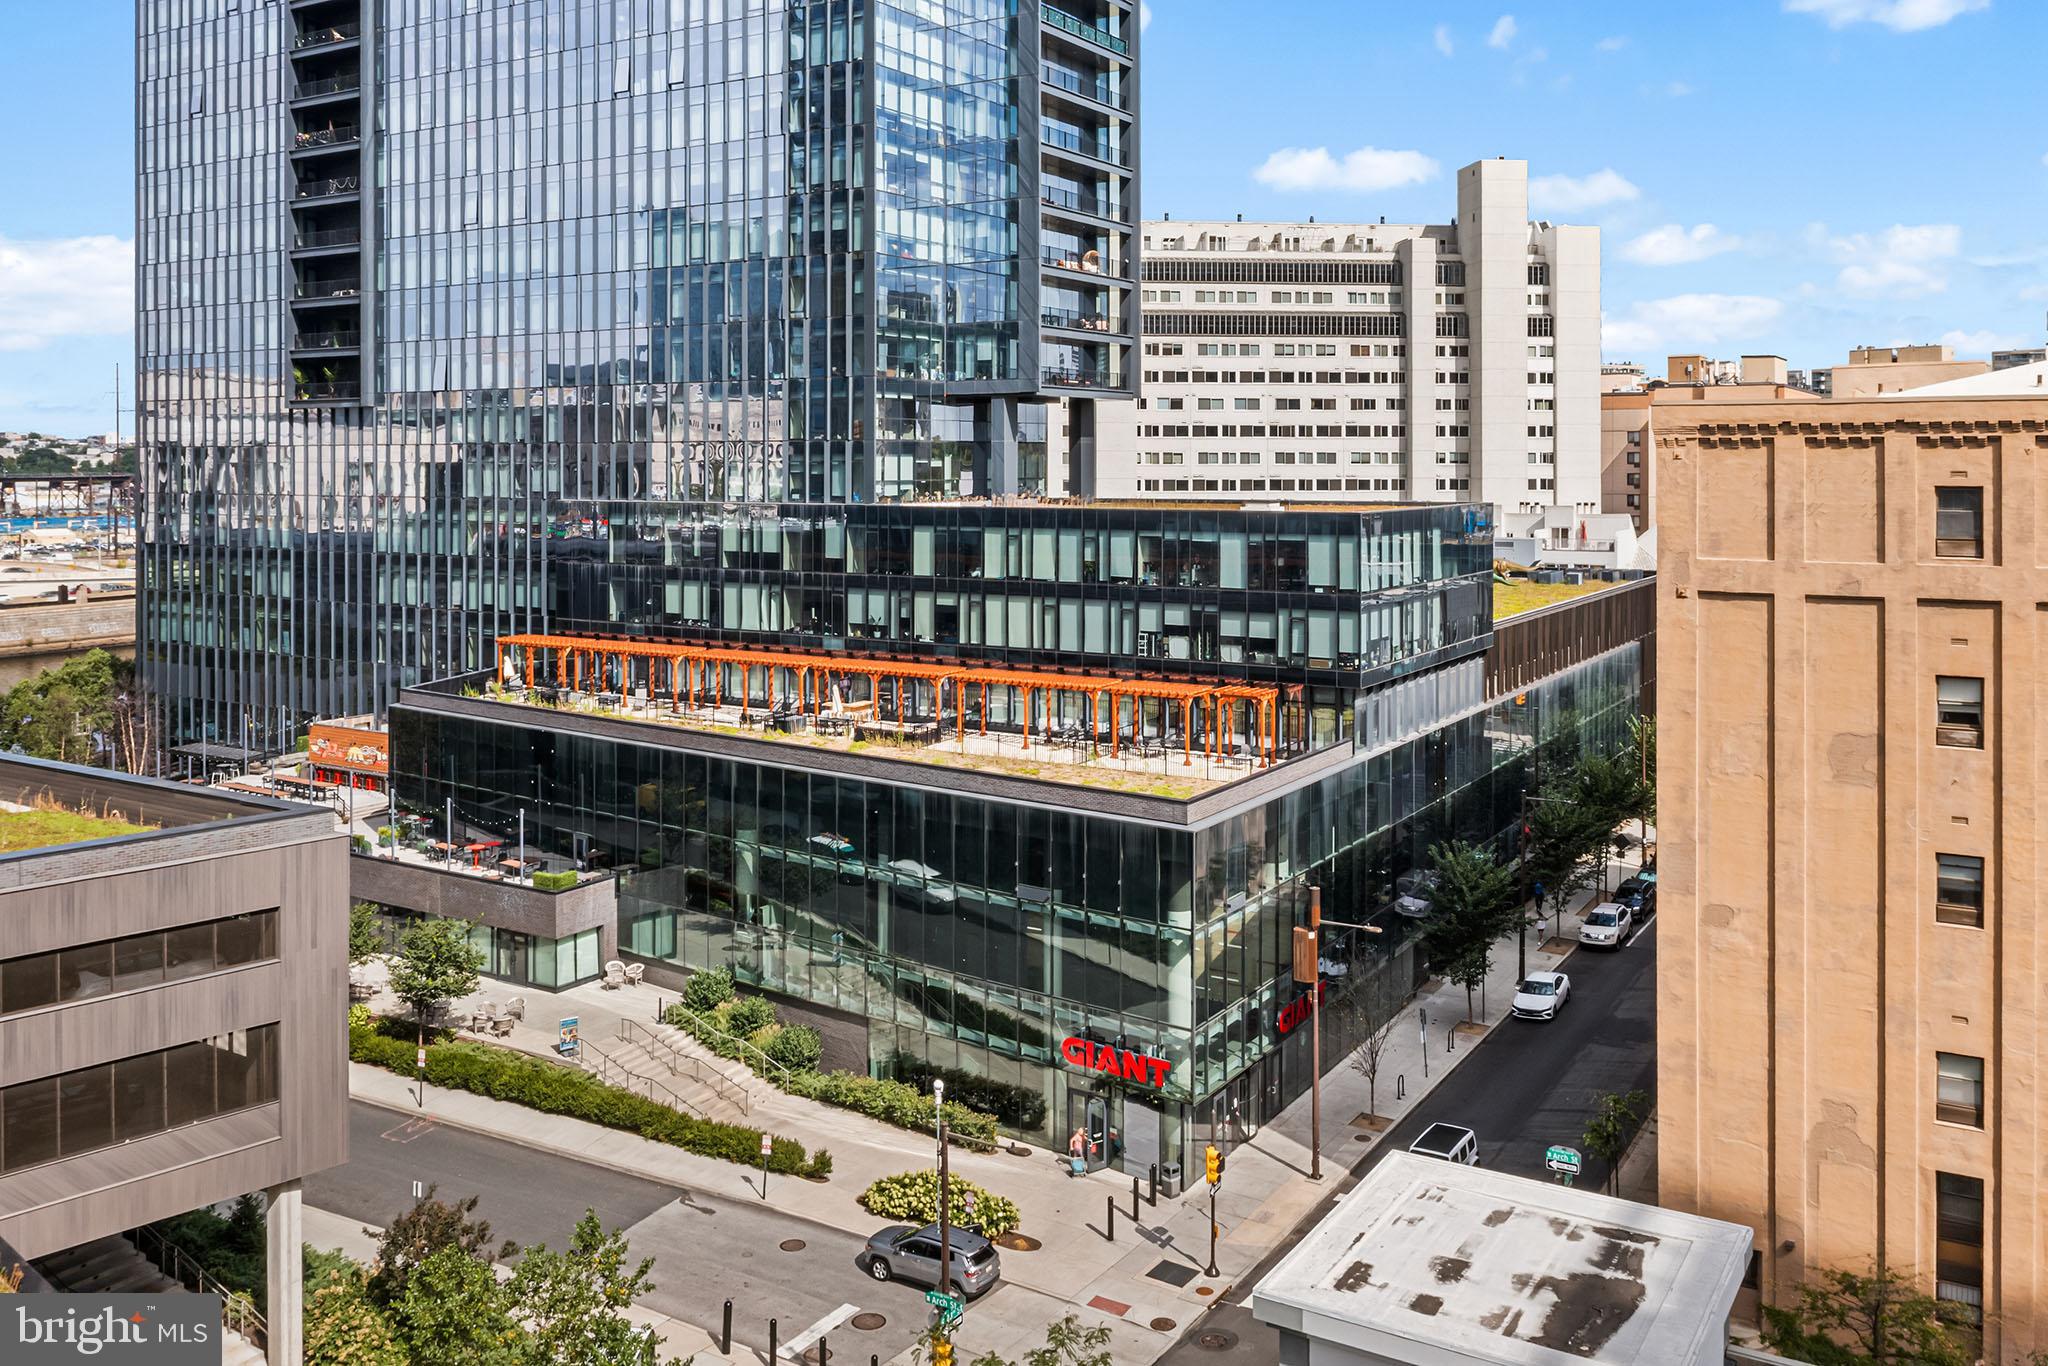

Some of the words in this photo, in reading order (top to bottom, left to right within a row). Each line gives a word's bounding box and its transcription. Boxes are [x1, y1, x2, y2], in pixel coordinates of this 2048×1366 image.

[1062, 1037, 1171, 1088] GIANT
[1552, 1152, 1569, 1161] Arch
[931, 1296, 948, 1307] Arch
